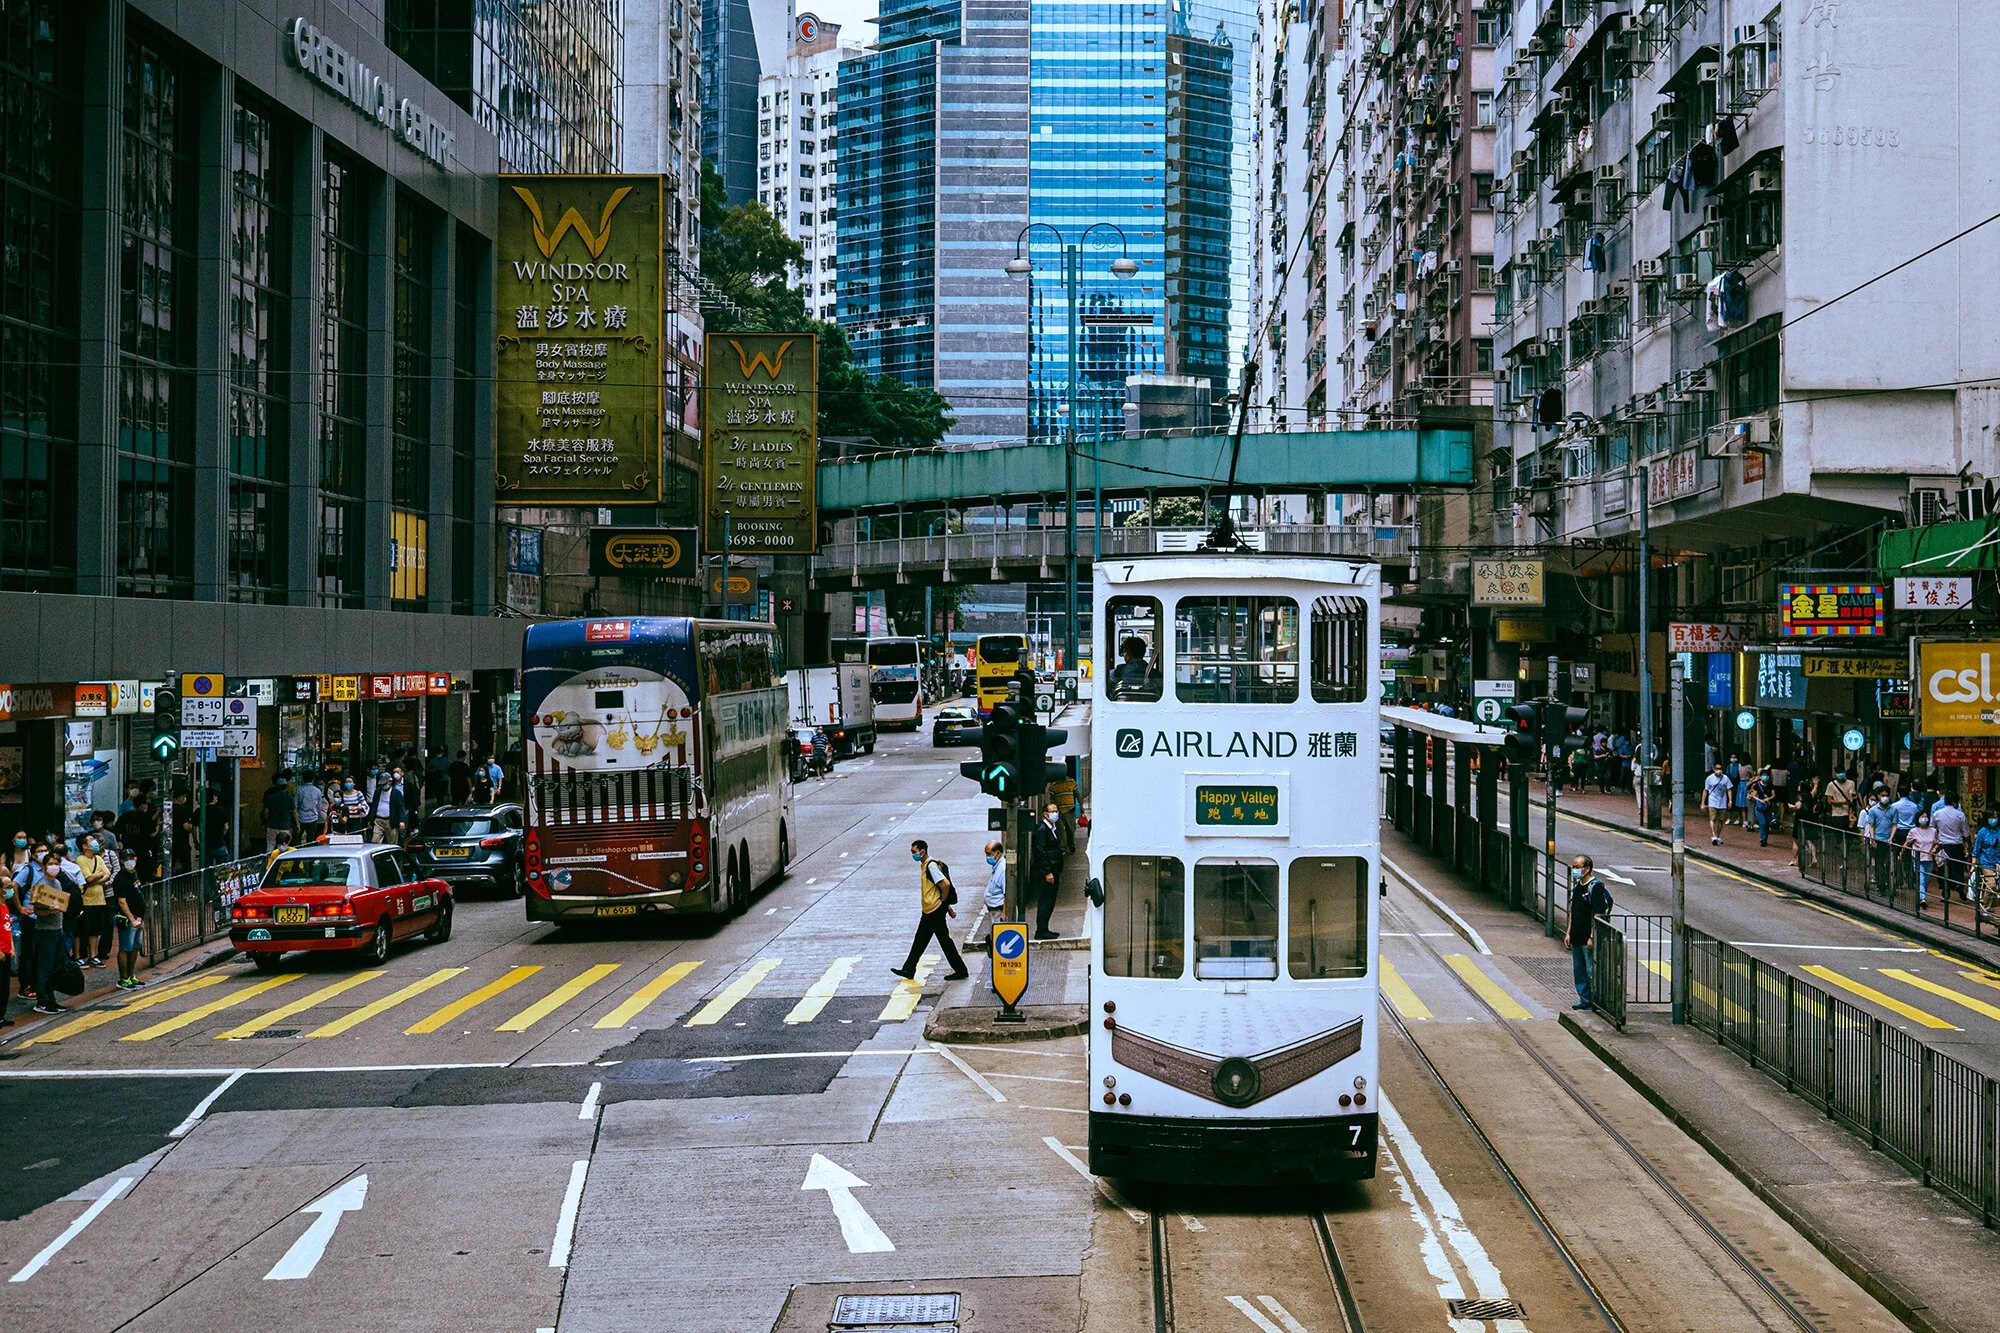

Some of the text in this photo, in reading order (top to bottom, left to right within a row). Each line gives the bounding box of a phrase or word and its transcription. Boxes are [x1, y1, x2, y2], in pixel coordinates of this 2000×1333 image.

[294, 17, 457, 175] GREENWICH CENTRE
[513, 261, 629, 280] WINDSOR
[552, 283, 590, 303] SPA
[535, 343, 608, 357] 男女賓按摩
[536, 360, 607, 370] Body Massage
[537, 371, 607, 381] 全身マッサージ
[725, 382, 797, 395] WINDSOR
[749, 397, 772, 408] SPA
[536, 407, 606, 417] Foot Massage
[541, 418, 601, 428] 足マッサージ
[528, 438, 615, 452] 水療美容服務
[730, 436, 793, 452] 3/F LADIES
[523, 454, 619, 464] Spa Facial Service
[717, 475, 803, 491] 2/F GENTLEMEN
[737, 522, 783, 531] BOOKING
[1122, 565, 1135, 581] 7
[1349, 566, 1361, 583] 7
[1478, 563, 1539, 579] 春夏秋冬
[1908, 581, 1958, 590] 中醫診所
[1792, 594, 1839, 618] 金星
[1839, 595, 1874, 606] GAME
[1672, 624, 1755, 641] 百福老人院
[585, 678, 639, 690] DUMBO
[120, 684, 137, 699] SUN
[198, 700, 222, 710] 8-10
[198, 714, 218, 722] 5-7
[241, 730, 249, 740] 7
[242, 746, 254, 755] 12
[1150, 731, 1358, 758] AIRLAND 雅蘭
[1199, 790, 1277, 806] Happy Valley
[1207, 807, 1269, 820] 跑馬地
[281, 914, 306, 923] 6507
[1348, 1126, 1362, 1146] 7
